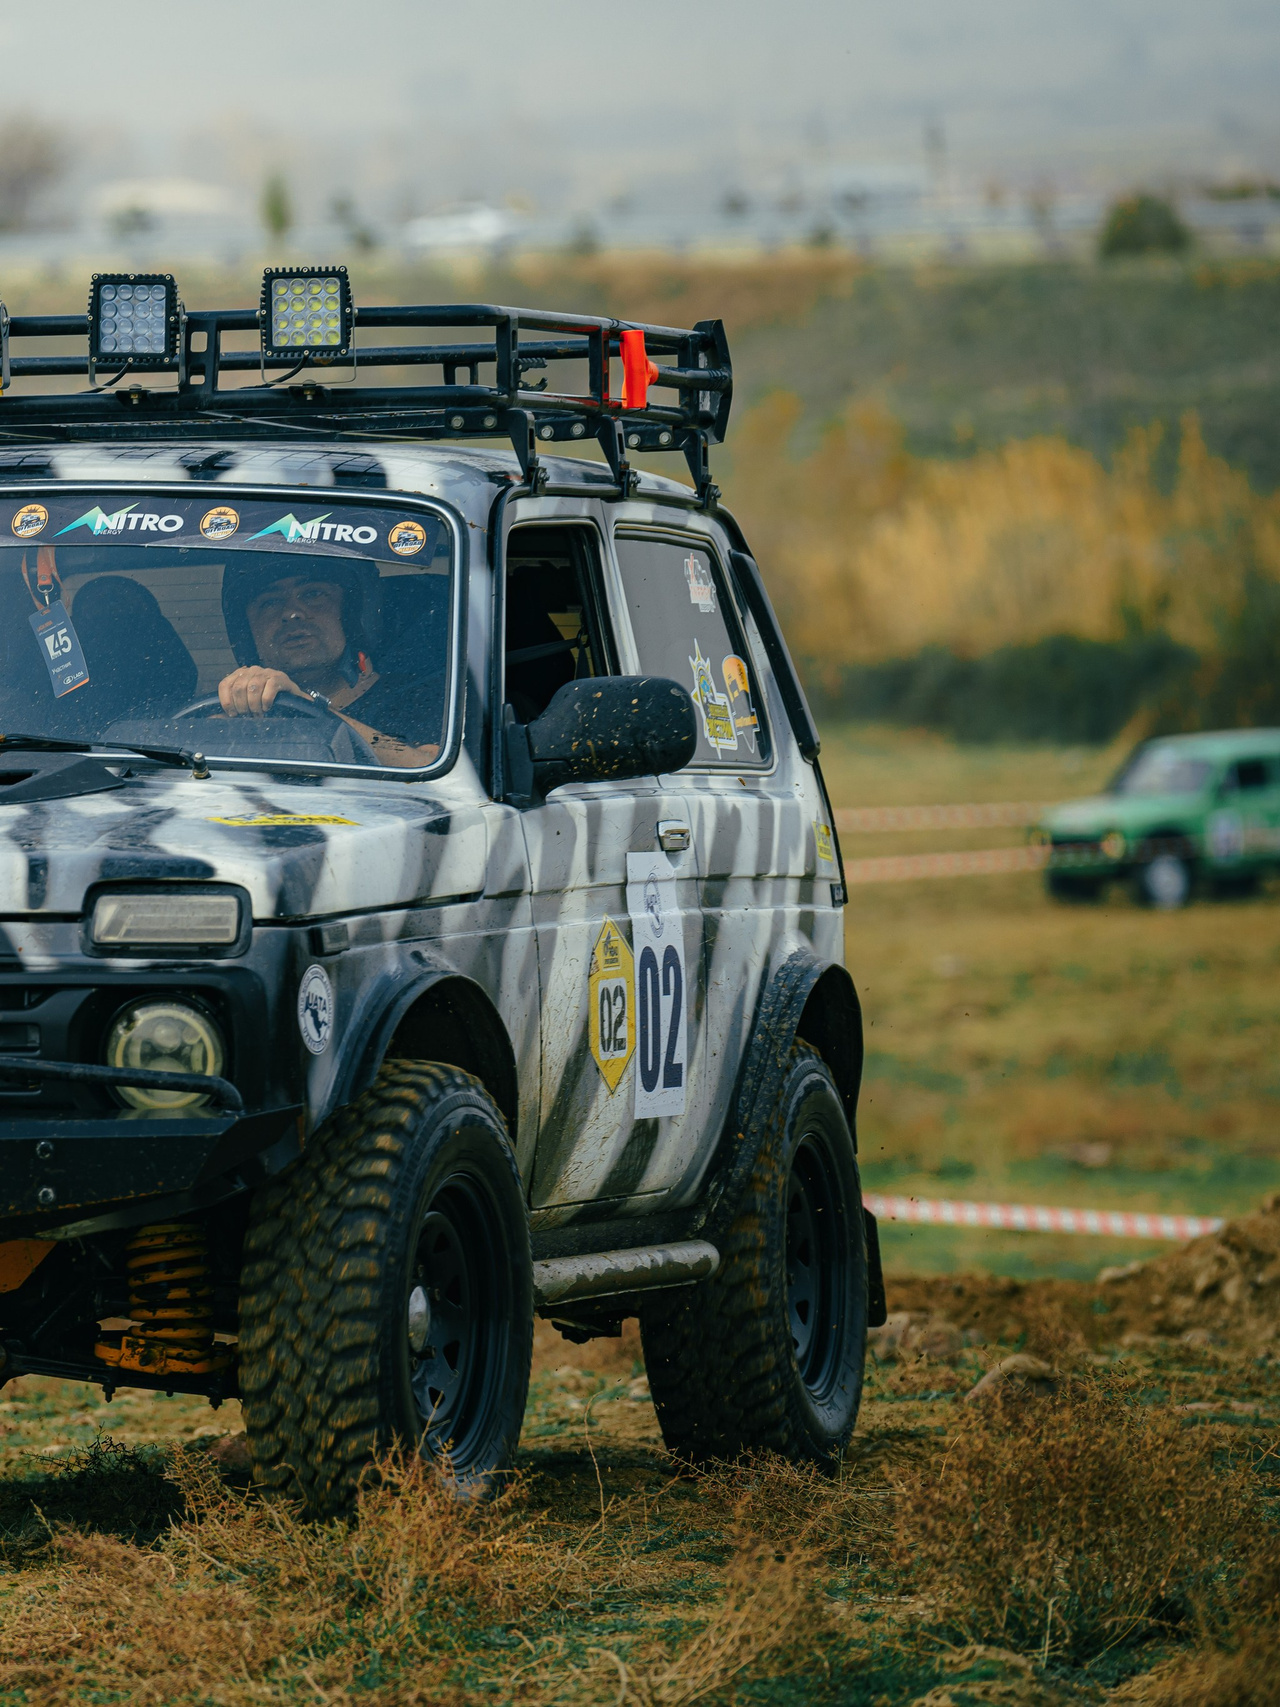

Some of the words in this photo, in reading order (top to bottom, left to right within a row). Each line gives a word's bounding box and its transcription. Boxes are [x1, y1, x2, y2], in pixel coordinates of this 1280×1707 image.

[94, 513, 184, 533] NITRO
[288, 520, 378, 544] NITRO
[599, 985, 627, 1053] 02
[639, 944, 683, 1093] 02
